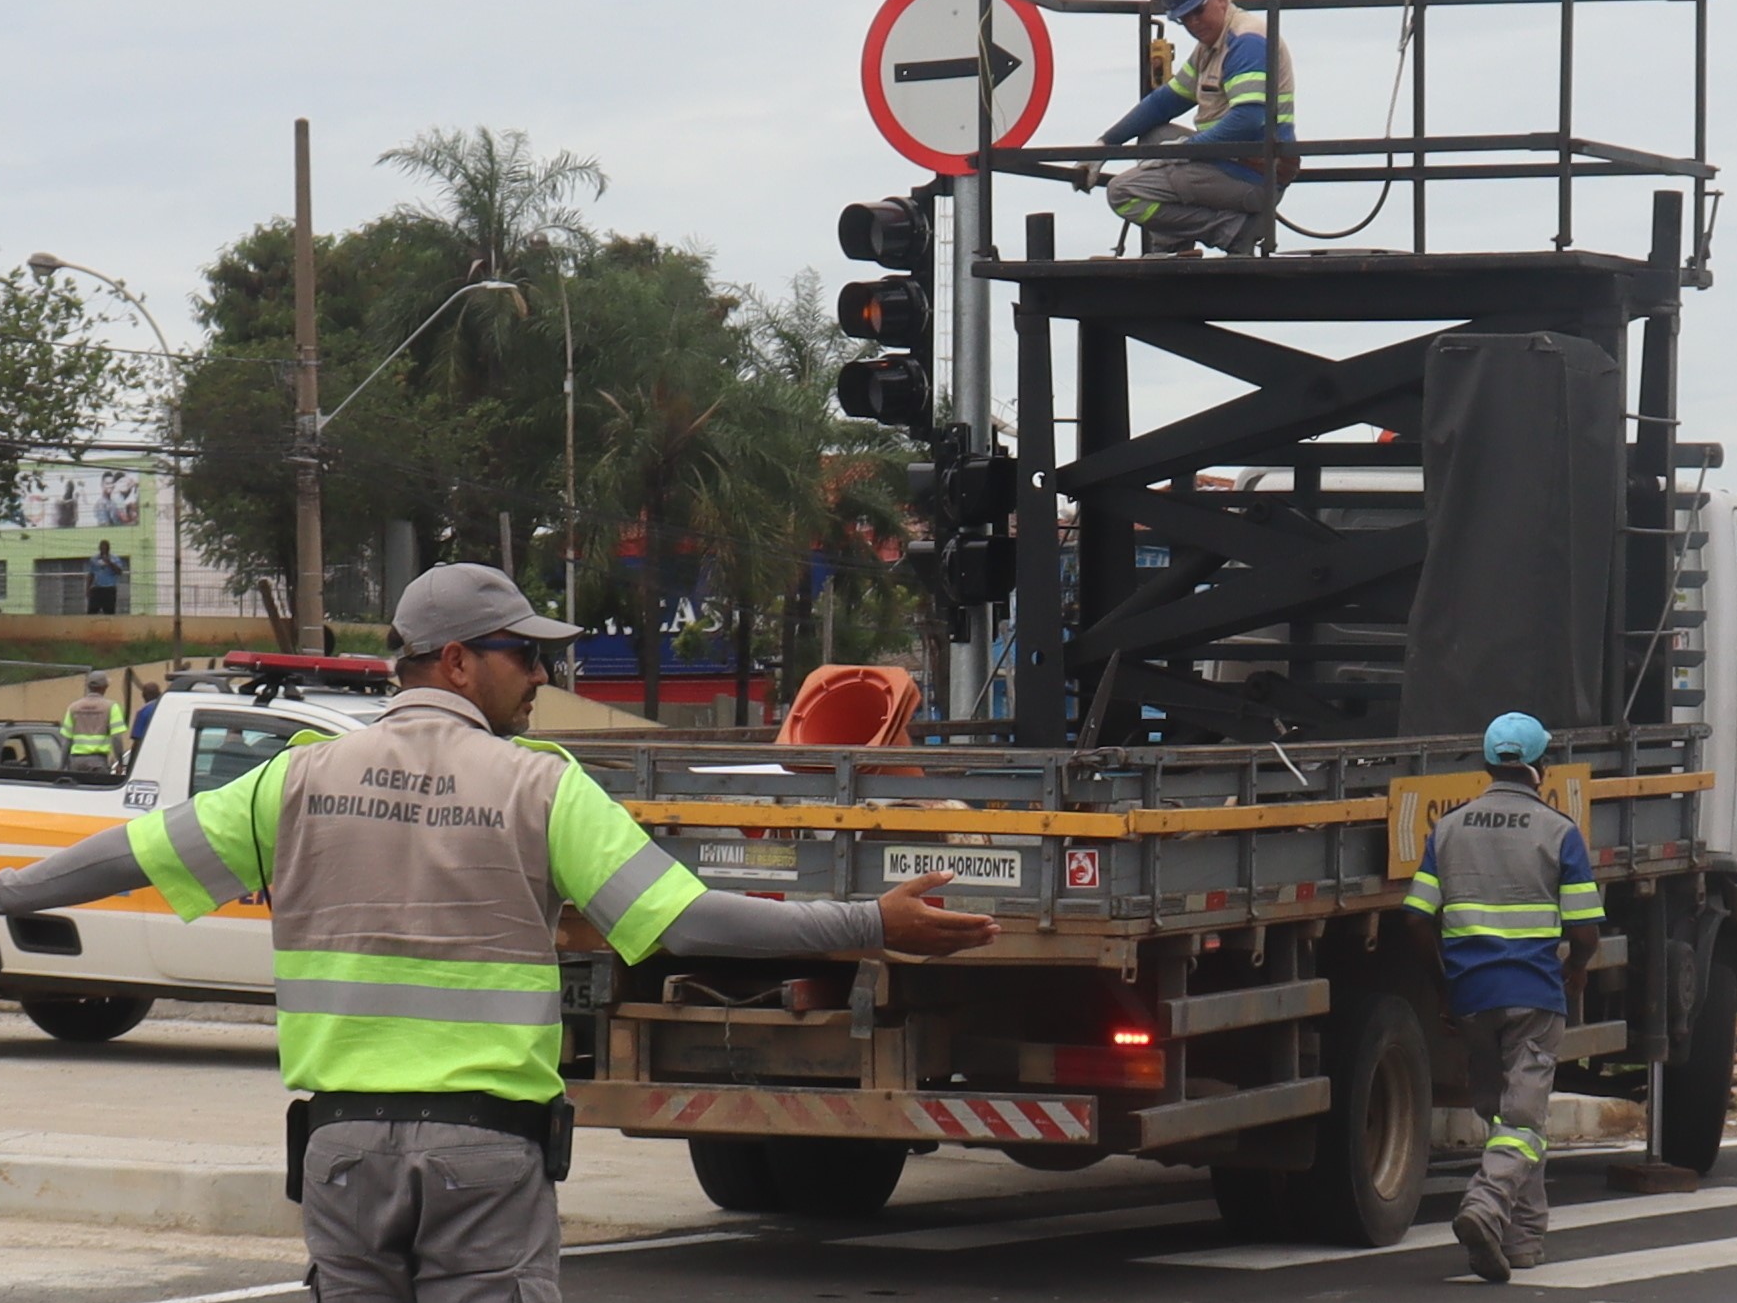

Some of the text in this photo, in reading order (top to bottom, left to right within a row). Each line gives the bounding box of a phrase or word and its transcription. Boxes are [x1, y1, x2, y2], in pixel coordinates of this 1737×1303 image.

[360, 767, 456, 796] AGENTE DA
[128, 793, 155, 806] 118
[426, 806, 506, 829] URBANA
[1463, 812, 1531, 829] EMDEC
[914, 854, 944, 874] BELO
[947, 856, 1016, 878] HORIZONTE
